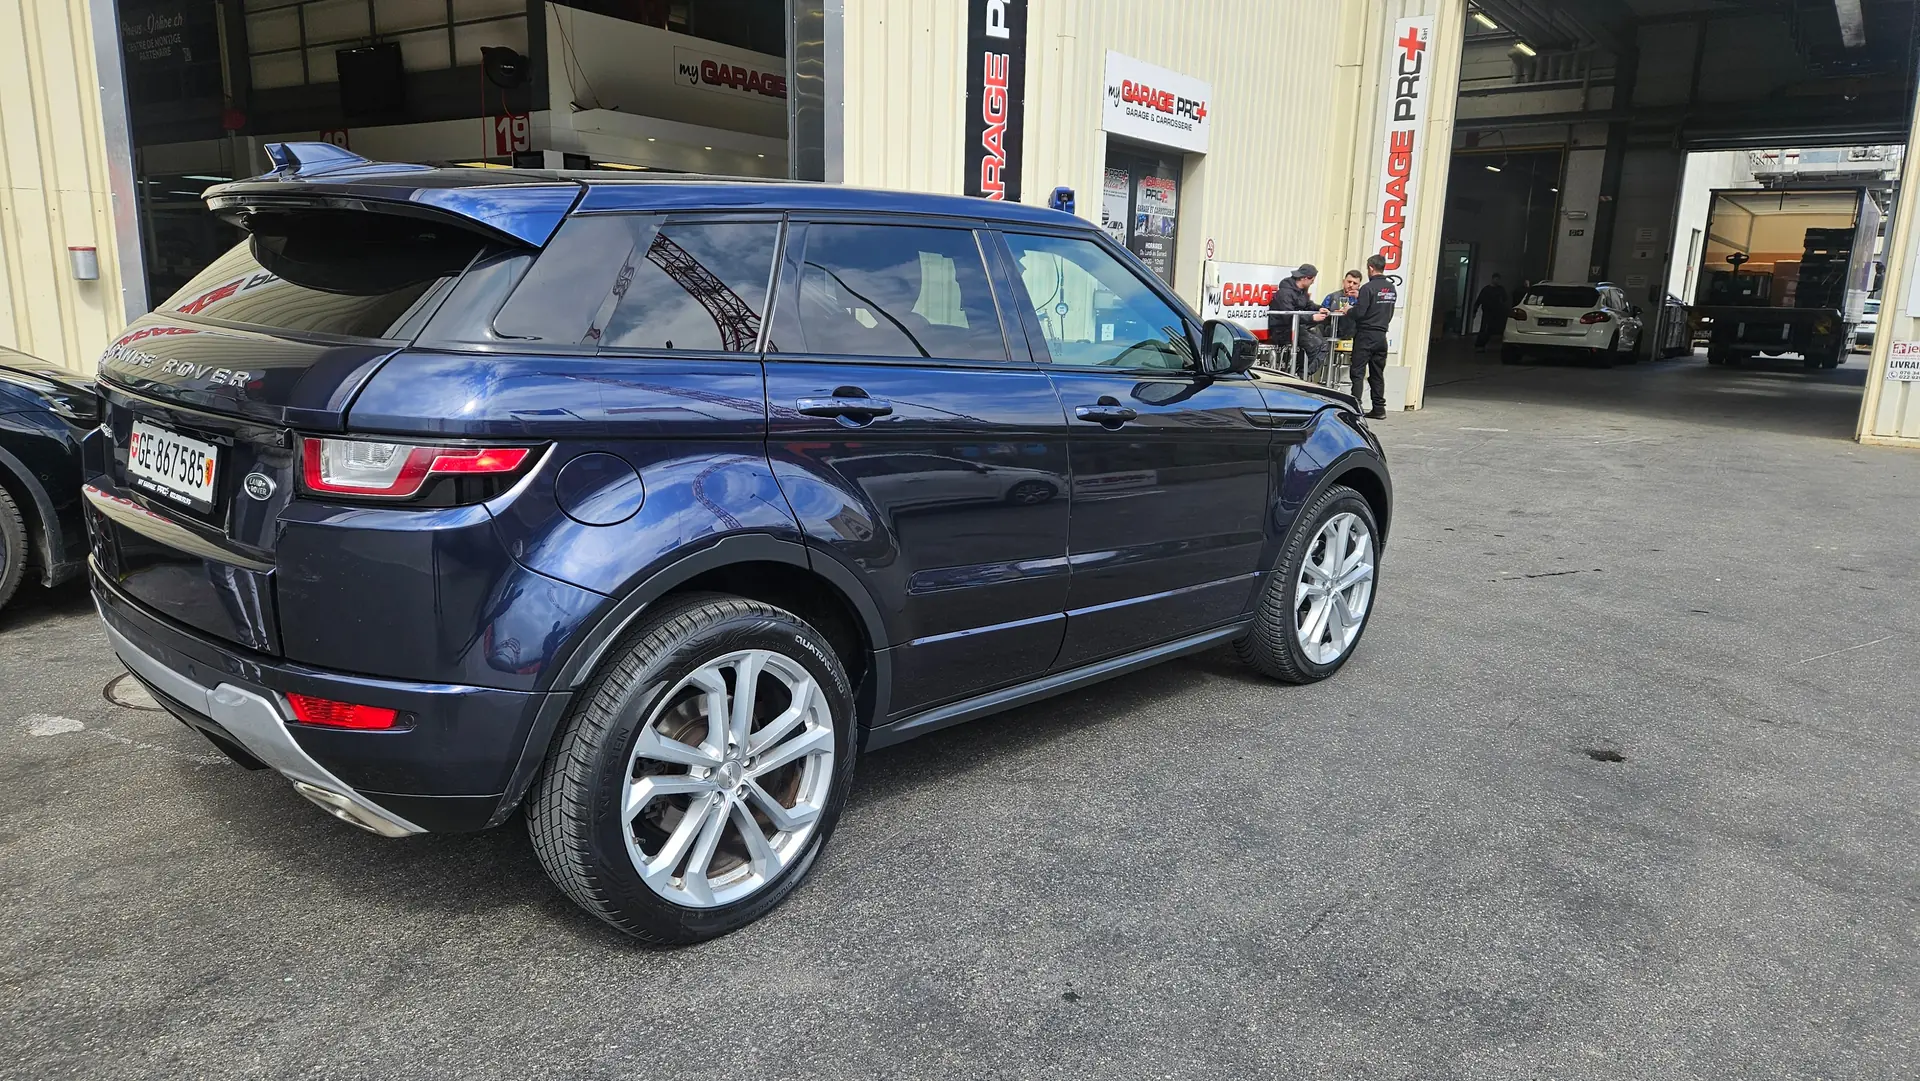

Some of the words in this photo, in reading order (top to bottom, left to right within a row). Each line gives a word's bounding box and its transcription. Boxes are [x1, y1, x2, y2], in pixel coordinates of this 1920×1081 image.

[679, 63, 699, 85] my
[701, 59, 788, 100] GARAGE
[1108, 85, 1120, 108] my
[1121, 79, 1175, 115] GARAGE
[497, 115, 530, 152] 19
[981, 51, 1010, 201] RAGE
[1125, 107, 1150, 121] GARAGE
[1150, 114, 1155, 122] &
[1155, 115, 1193, 132] CARROSSERIE
[1378, 130, 1416, 271] GARAGE
[1208, 292, 1221, 315] my
[1227, 309, 1252, 319] GARAGE
[1253, 310, 1257, 318] &
[161, 358, 252, 388] ROVER
[794, 634, 833, 672] QUATRAC
